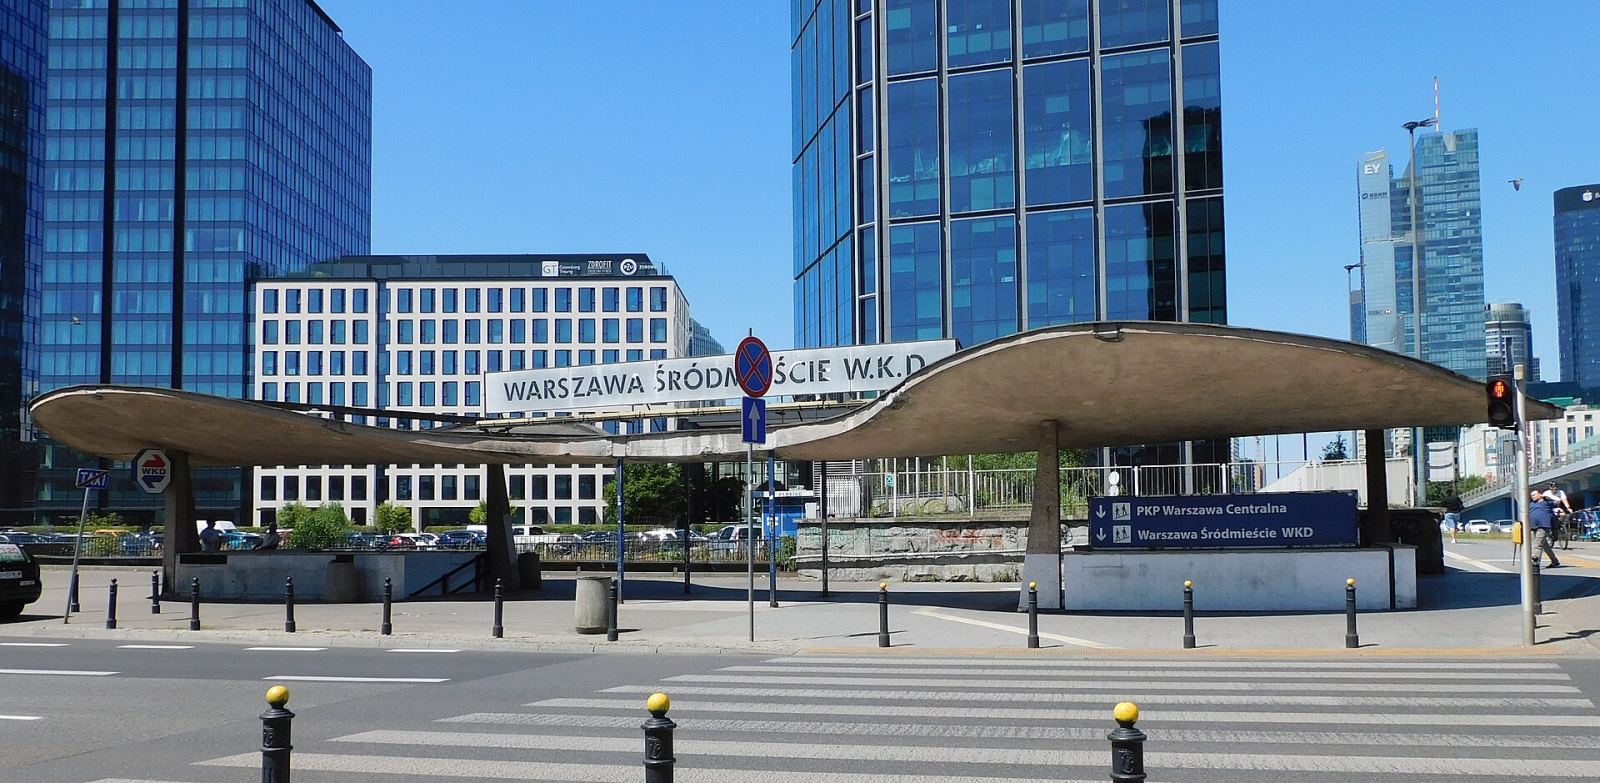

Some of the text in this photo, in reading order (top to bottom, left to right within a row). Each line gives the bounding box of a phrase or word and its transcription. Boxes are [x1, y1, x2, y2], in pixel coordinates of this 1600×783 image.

[1364, 163, 1381, 175] EY
[543, 265, 557, 274] GT
[587, 260, 613, 269] ZDROFIT
[503, 373, 645, 401] WARSZAWA
[654, 355, 831, 393] ŚRÓDMŚCIE
[142, 467, 166, 475] WKD
[80, 471, 107, 487] TAXI
[1136, 502, 1287, 516] PKP Warszawa Centralna
[1137, 526, 1314, 540] Warszawa Śródmieście WKD
